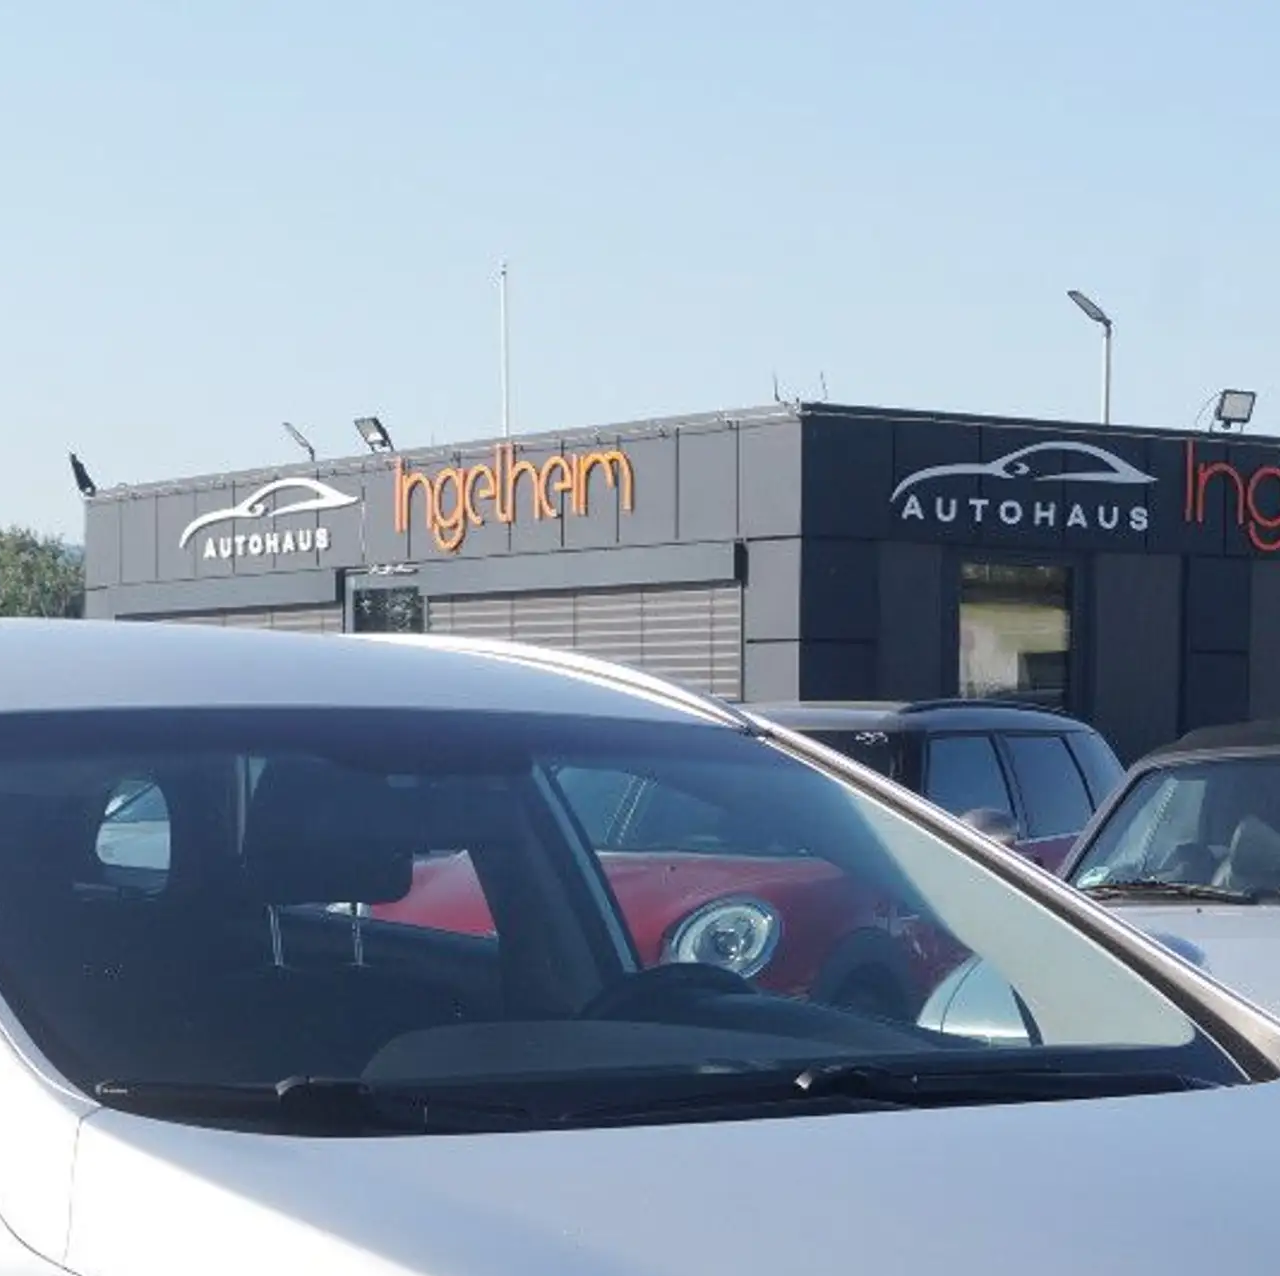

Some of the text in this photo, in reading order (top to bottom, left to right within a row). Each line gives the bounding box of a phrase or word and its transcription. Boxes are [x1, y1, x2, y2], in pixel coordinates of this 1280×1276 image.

[394, 444, 634, 552] Ingelheim
[901, 494, 1149, 531] AUTOHAUS
[203, 528, 330, 559] AUTOHAUS
